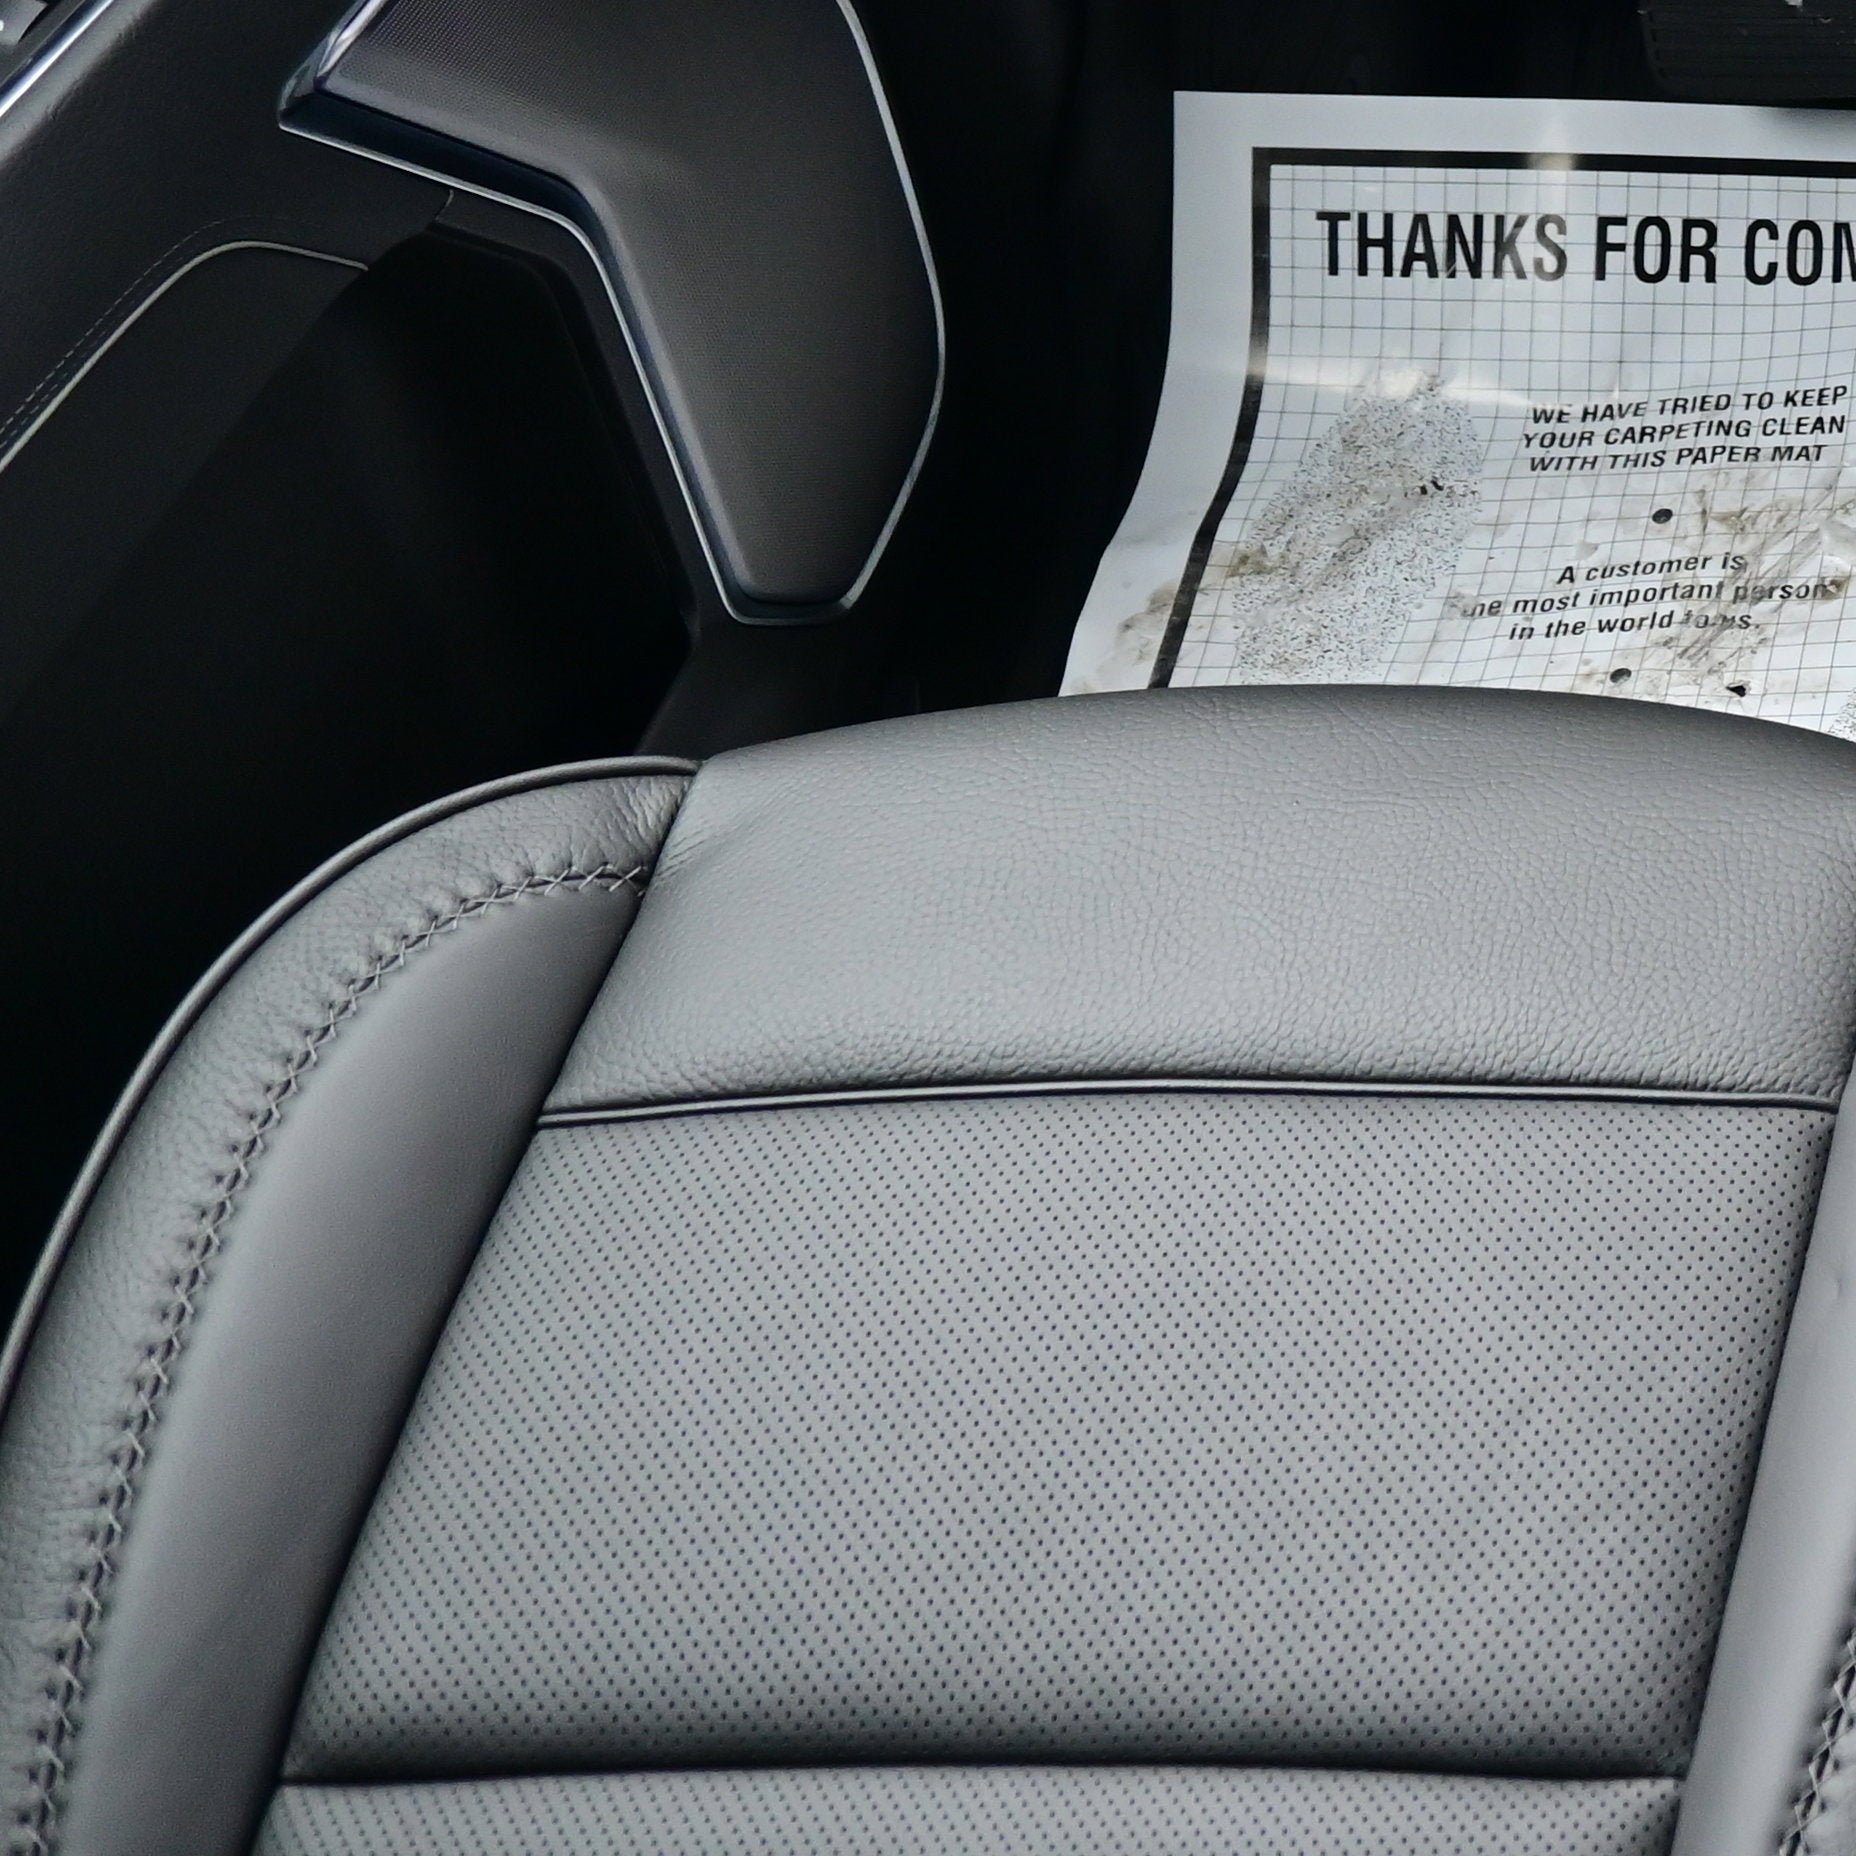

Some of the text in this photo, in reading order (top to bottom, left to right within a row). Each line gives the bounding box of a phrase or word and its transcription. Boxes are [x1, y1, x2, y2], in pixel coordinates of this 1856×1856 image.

[1316, 211, 1568, 282] THANKS
[1594, 215, 1717, 284] FOR
[1531, 385, 1848, 425] WE HAVE TRIED TO KEEP
[1523, 414, 1846, 449] YOUR CARPETING CLEAN
[1529, 444, 1829, 472] WITH THIS PAPER MAT
[1556, 551, 1746, 584] A customer is
[1512, 591, 1581, 614] most
[1588, 580, 1724, 608] important
[1508, 623, 1535, 641] in
[1544, 619, 1586, 639] the
[1598, 610, 1674, 633] world
